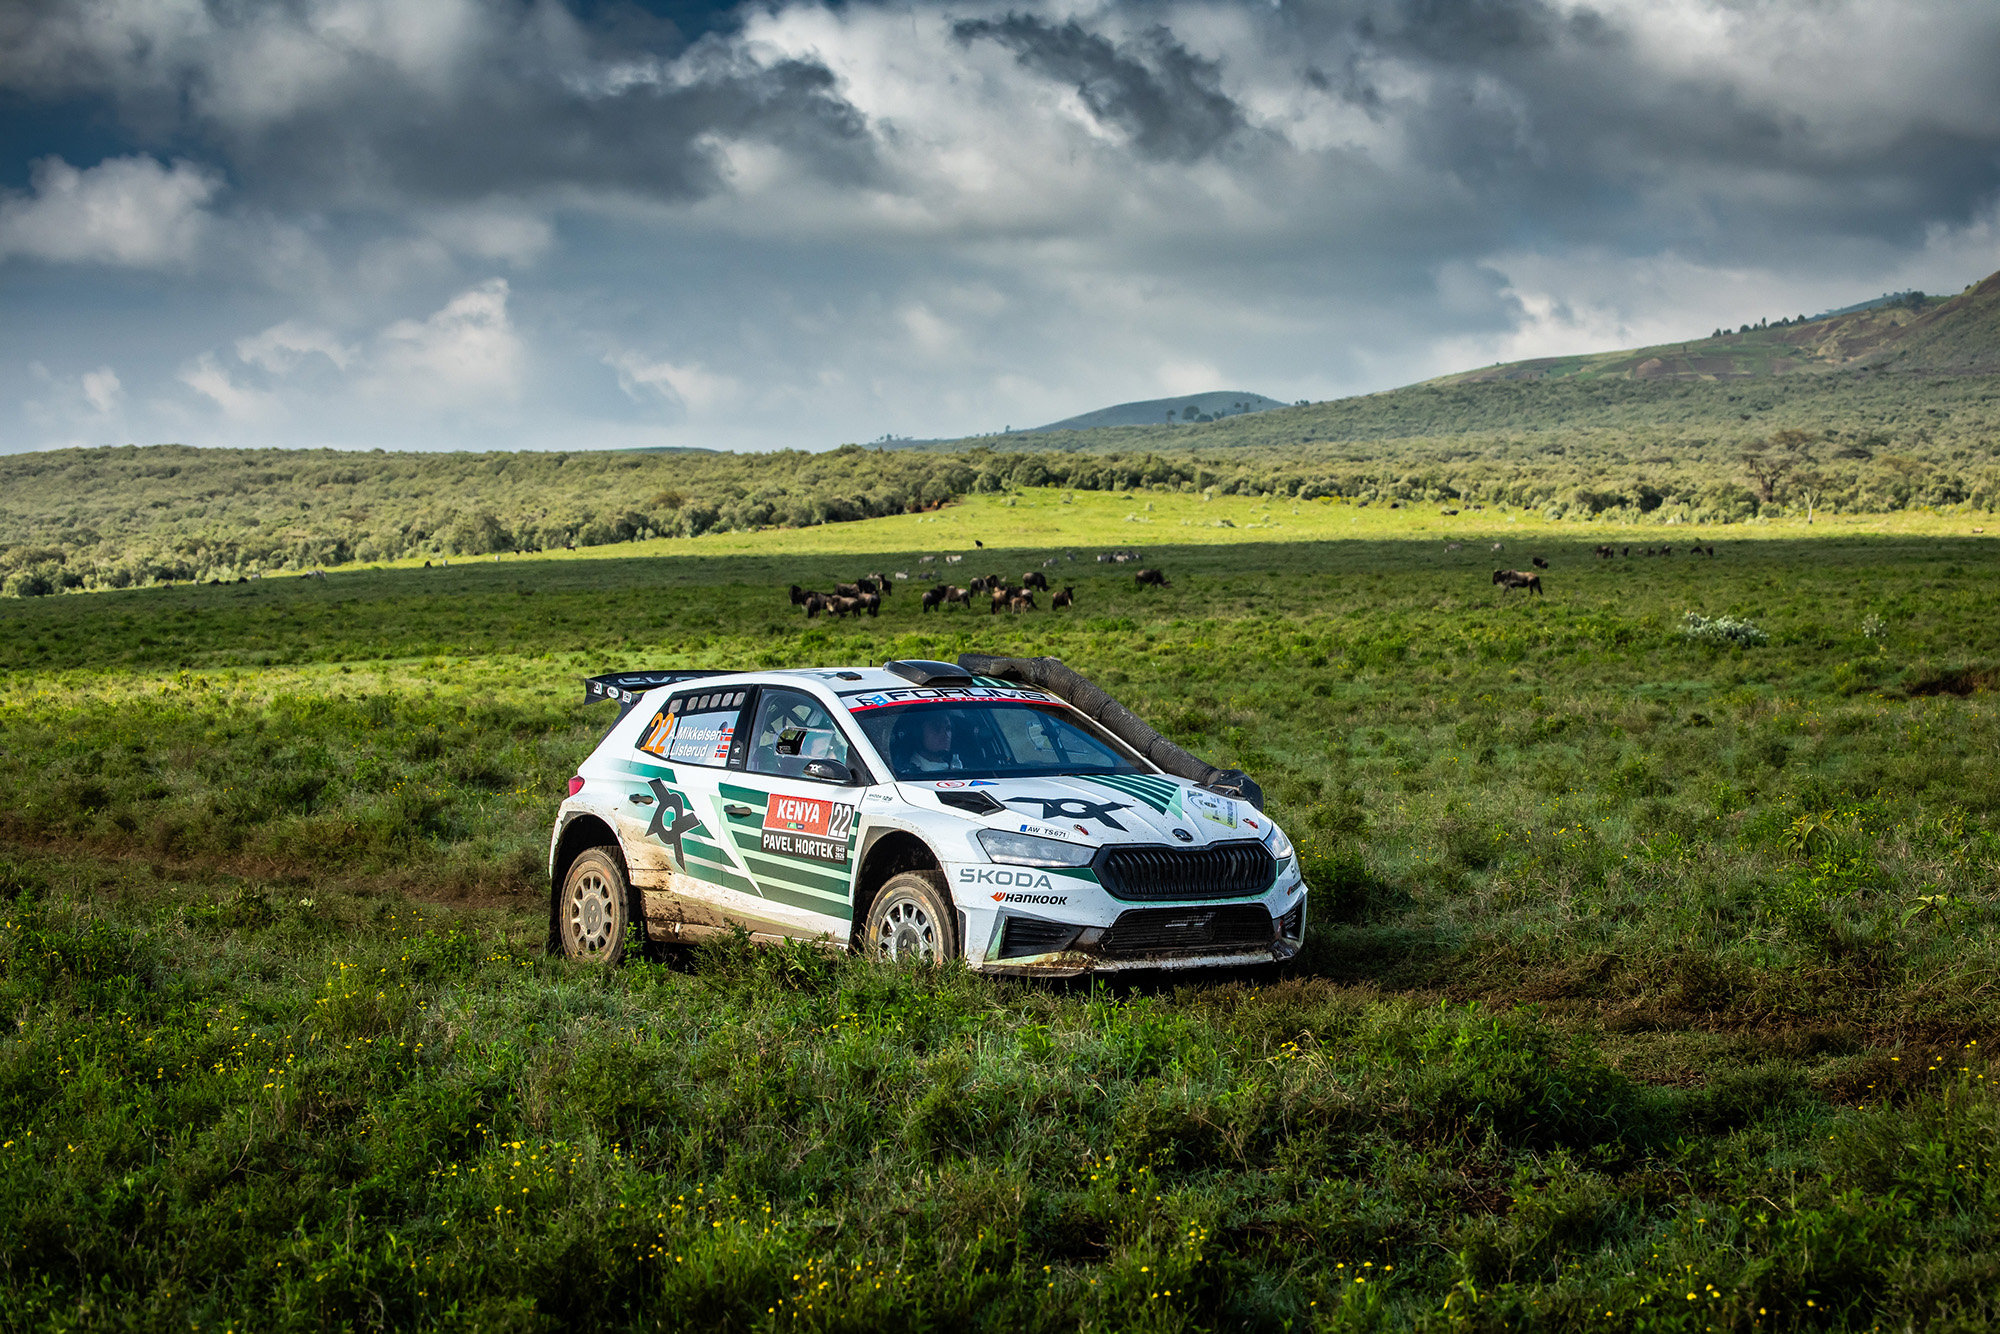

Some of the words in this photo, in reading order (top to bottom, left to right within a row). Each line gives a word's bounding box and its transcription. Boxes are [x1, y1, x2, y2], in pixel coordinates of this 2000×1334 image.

[640, 712, 675, 754] 22
[777, 799, 820, 824] KENYA
[830, 804, 852, 838] 22
[1027, 826, 1040, 834] AW
[763, 834, 793, 852] PAVEL
[795, 839, 834, 858] HORTEK
